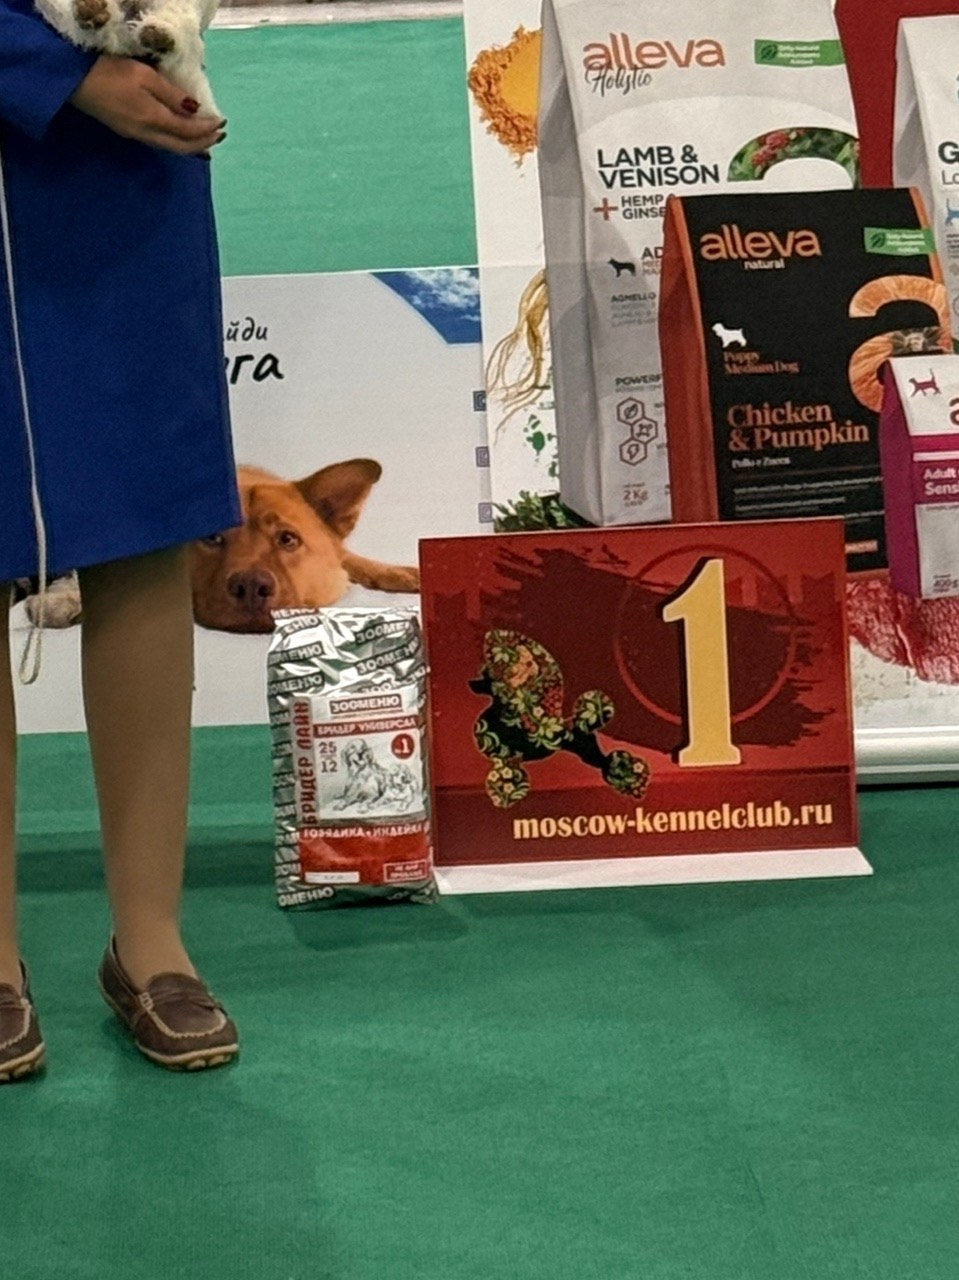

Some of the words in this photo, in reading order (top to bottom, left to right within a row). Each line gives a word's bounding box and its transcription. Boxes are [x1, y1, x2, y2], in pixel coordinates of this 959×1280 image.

[582, 32, 726, 71] alleva
[597, 145, 675, 168] LAMB
[680, 144, 699, 164] &
[598, 164, 720, 189] VENISON
[621, 194, 664, 208] HEMP
[700, 224, 822, 261] alleva
[744, 258, 785, 270] natural
[224, 352, 284, 385] га
[726, 400, 832, 428] Chicken
[728, 428, 750, 452] &
[753, 420, 870, 451] Pumpkin
[924, 468, 956, 480] Adult
[662, 556, 741, 767] 1
[332, 696, 399, 713] ЗООМЕНЮ
[318, 741, 337, 754] 25
[321, 761, 338, 773] 12
[298, 756, 318, 825] БРИДЕР
[513, 800, 833, 840] moscow-kennelclub.ru
